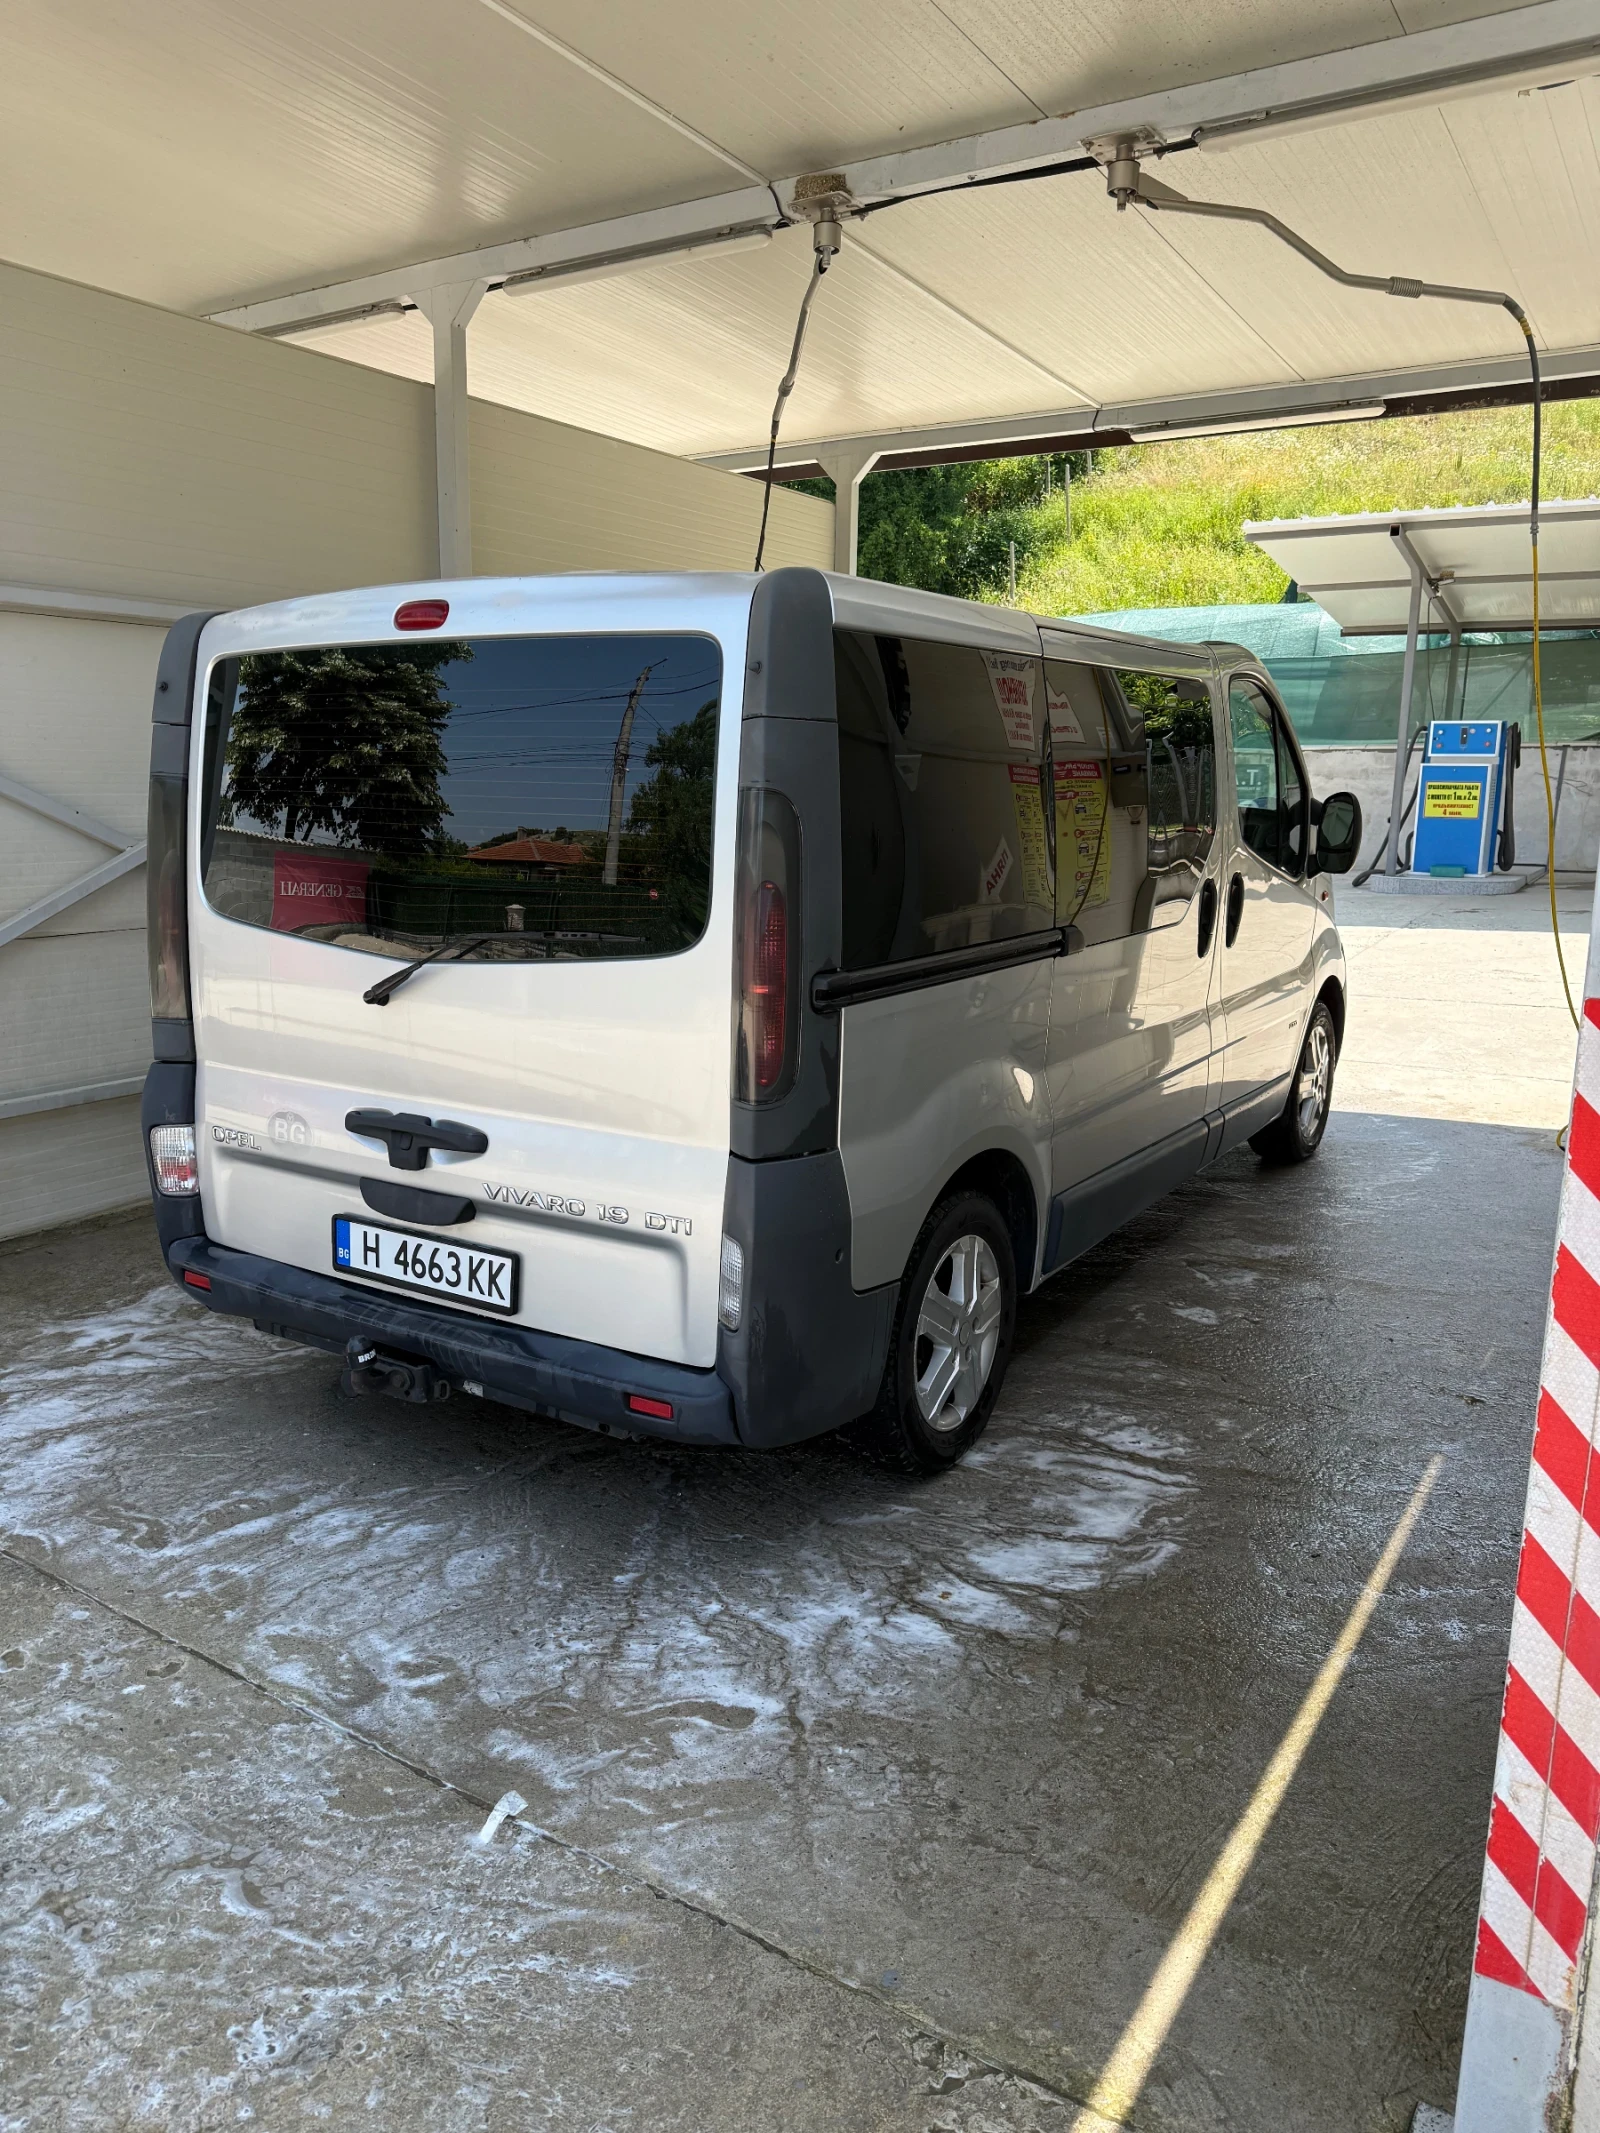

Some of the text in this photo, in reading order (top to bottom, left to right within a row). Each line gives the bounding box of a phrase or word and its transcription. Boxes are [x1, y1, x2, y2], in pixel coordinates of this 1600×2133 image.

[1467, 791, 1473, 800] 2
[211, 1126, 262, 1151] OPEL
[274, 1118, 306, 1145] BG
[482, 1182, 585, 1217] VIVARO
[644, 1211, 693, 1236] DTI
[337, 1247, 350, 1259] BG
[362, 1231, 506, 1301] H 4663 KK
